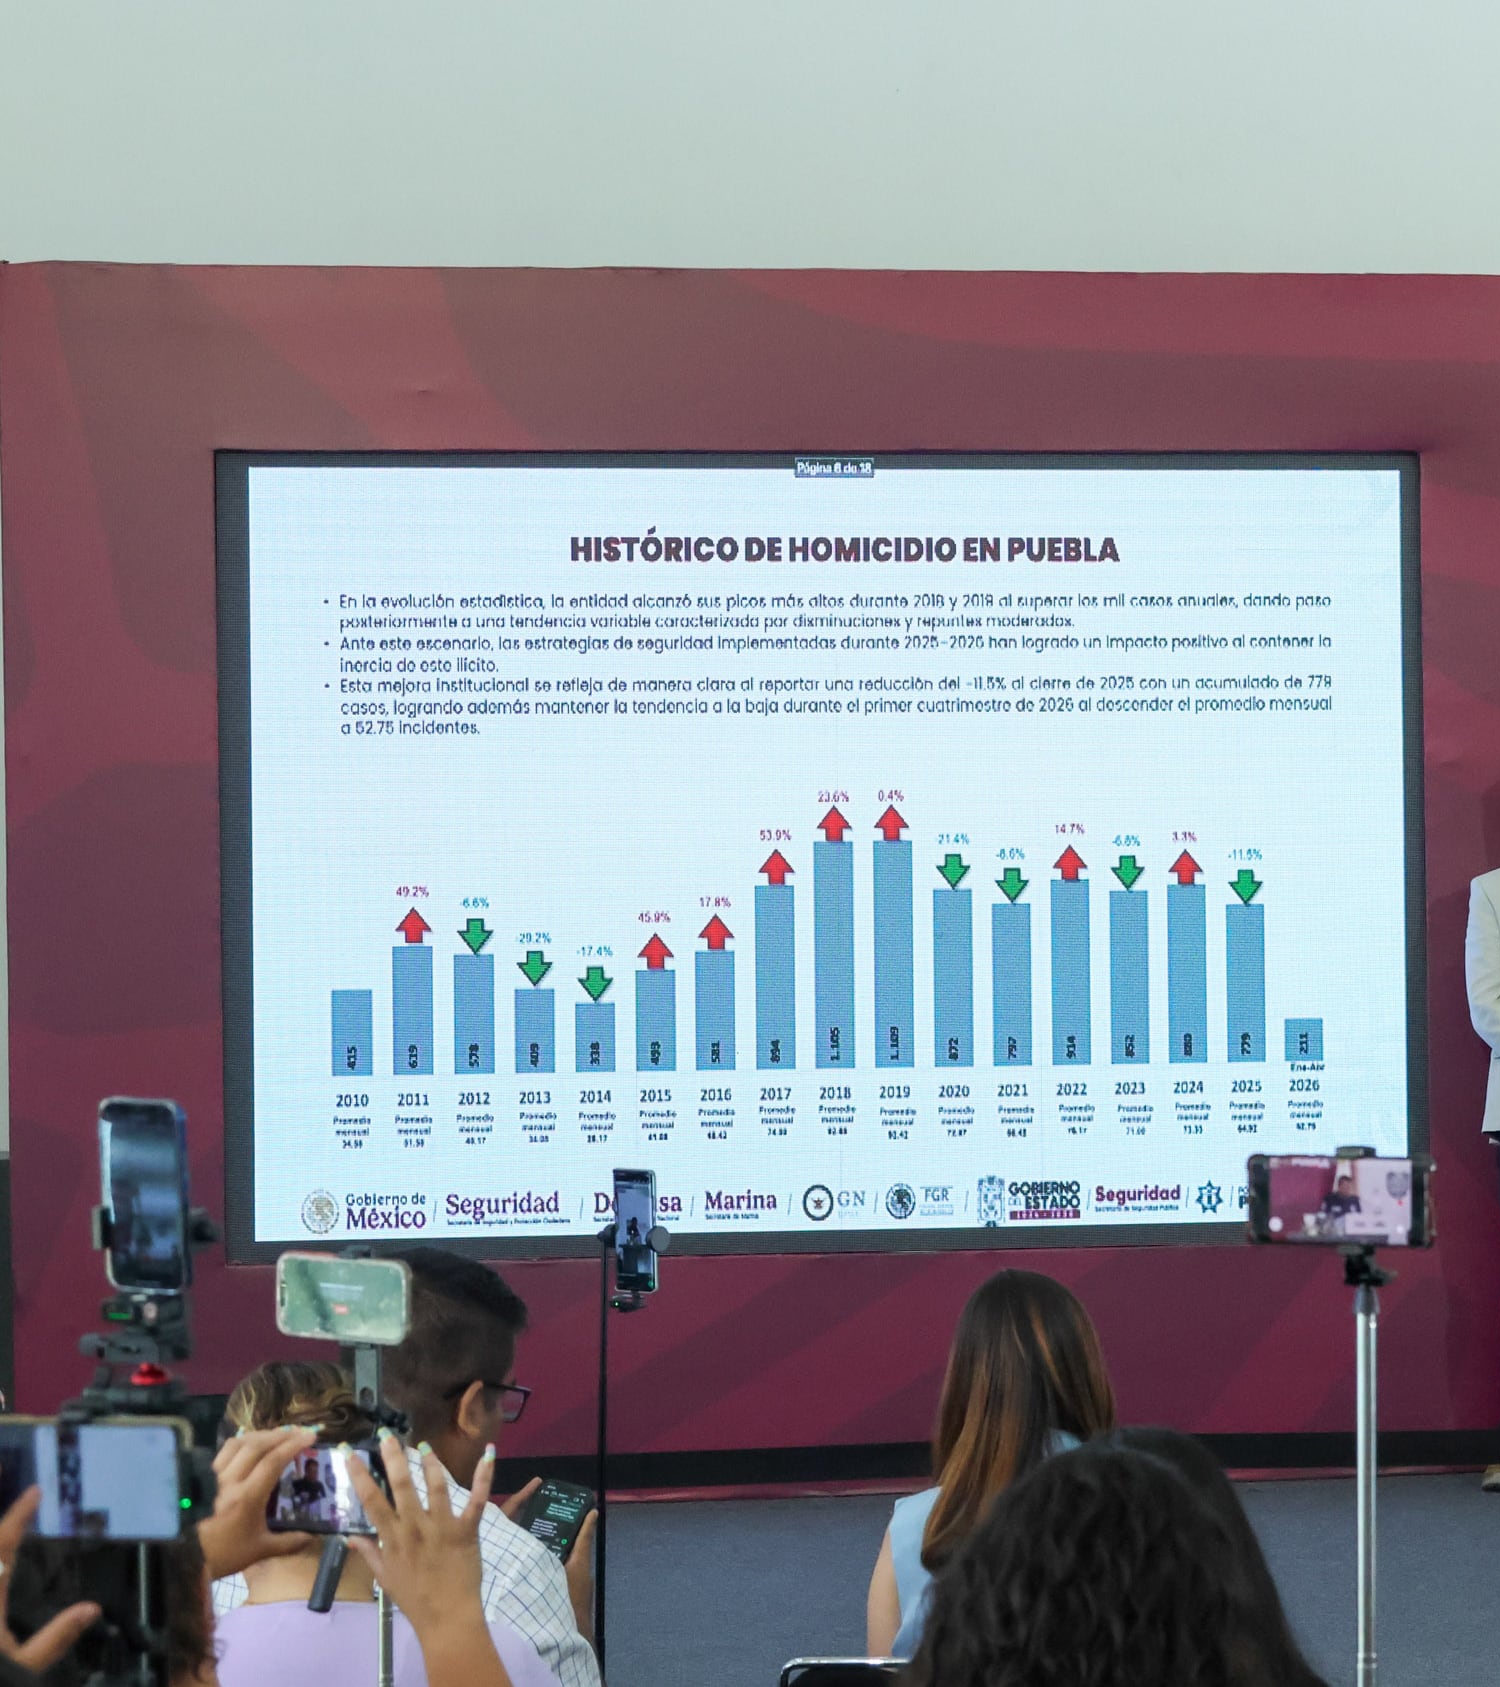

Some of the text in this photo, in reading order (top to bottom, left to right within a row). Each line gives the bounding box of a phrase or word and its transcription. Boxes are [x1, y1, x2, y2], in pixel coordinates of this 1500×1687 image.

[859, 462, 872, 474] 18
[570, 525, 1121, 563] HISTÓRICO DE HOMICIDIO EN PUEBLA
[339, 593, 358, 609] En
[361, 594, 377, 609] la
[380, 593, 455, 609] evolución
[550, 593, 565, 608] la
[569, 593, 629, 608] entidad
[632, 593, 693, 609] alcanzó
[696, 596, 722, 608] sus
[725, 593, 767, 612] picos
[771, 593, 805, 608] más
[808, 593, 845, 608] altos
[849, 593, 909, 608] durante
[948, 596, 958, 612] y
[998, 593, 1013, 607] al
[1017, 595, 1074, 612] superar
[1077, 593, 1099, 607] los
[1102, 593, 1125, 607] mil
[1129, 595, 1174, 607] casos
[1242, 593, 1291, 607] dando
[1295, 595, 1332, 611] paso
[339, 636, 376, 651] Ante
[379, 636, 412, 651] este
[498, 636, 521, 650] las
[524, 635, 610, 655] estrategias
[613, 635, 634, 650] de
[637, 636, 714, 654] seguridad
[717, 635, 837, 654] implementadas
[840, 635, 900, 649] durante
[988, 636, 1018, 648] han
[1021, 635, 1080, 654] logrado
[1083, 637, 1102, 648] un
[1106, 635, 1168, 651] impacto
[1171, 635, 1229, 652] positivo
[1231, 635, 1245, 648] al
[1249, 635, 1314, 647] contener
[1318, 635, 1332, 647] la
[339, 657, 393, 674] inercia
[396, 657, 417, 673] de
[419, 658, 453, 673] este
[340, 678, 373, 694] Esta
[377, 678, 432, 697] mejora
[436, 677, 529, 693] institucional
[534, 680, 552, 692] se
[556, 678, 603, 696] refleja
[607, 678, 628, 692] de
[632, 679, 692, 692] manera
[696, 677, 736, 691] clara
[740, 677, 754, 691] al
[759, 678, 819, 694] reportar
[824, 679, 854, 691] una
[858, 677, 934, 691] reducción
[938, 676, 961, 690] del
[1011, 676, 1024, 689] al
[1029, 678, 1071, 689] cierre
[1076, 676, 1095, 689] de
[1139, 678, 1167, 689] con
[1172, 678, 1190, 689] un
[1195, 675, 1280, 689] acumulado
[1284, 675, 1303, 688] de
[393, 699, 464, 719] logrando
[466, 698, 531, 715] además
[534, 700, 610, 715] mantener
[613, 698, 628, 715] la
[632, 698, 709, 715] tendencia
[712, 701, 723, 714] a
[726, 698, 741, 714] la
[744, 697, 779, 717] baja
[782, 698, 843, 714] durante
[846, 698, 860, 714] el
[864, 697, 913, 716] primer
[916, 697, 1012, 713] cuatrimestre
[1015, 697, 1035, 713] de
[1077, 697, 1092, 713] al
[1096, 696, 1174, 712] descender
[1177, 696, 1191, 712] el
[1194, 695, 1266, 714] promedio
[1269, 695, 1333, 711] mensual
[340, 723, 352, 736] a
[877, 789, 904, 802] 0.4%
[408, 1045, 418, 1069] 619
[879, 1085, 909, 1099] 2019
[938, 1084, 969, 1098] 2020
[997, 1083, 1028, 1098] 2021
[1056, 1082, 1087, 1096] 2022
[1114, 1081, 1146, 1095] 2023
[1173, 1080, 1204, 1094] 2024
[1231, 1079, 1263, 1093] 2025
[1289, 1078, 1320, 1092] 2026
[335, 1093, 370, 1108] 2010
[397, 1092, 429, 1107] 2011
[458, 1091, 490, 1106] 2012
[519, 1090, 552, 1105] 2013
[579, 1089, 612, 1104] 2014
[639, 1089, 671, 1103] 2015
[700, 1088, 731, 1102] 2016
[759, 1087, 790, 1101] 2017
[819, 1086, 850, 1100] 2018
[1008, 1180, 1081, 1196] GOBIERNO
[1095, 1184, 1181, 1206] Seguridad
[346, 1192, 426, 1207] Gobierno de
[445, 1190, 560, 1221] Seguridad
[704, 1189, 777, 1211] Marina
[837, 1190, 866, 1208] GN
[1025, 1194, 1081, 1210] ESTADO
[346, 1205, 427, 1231] México
